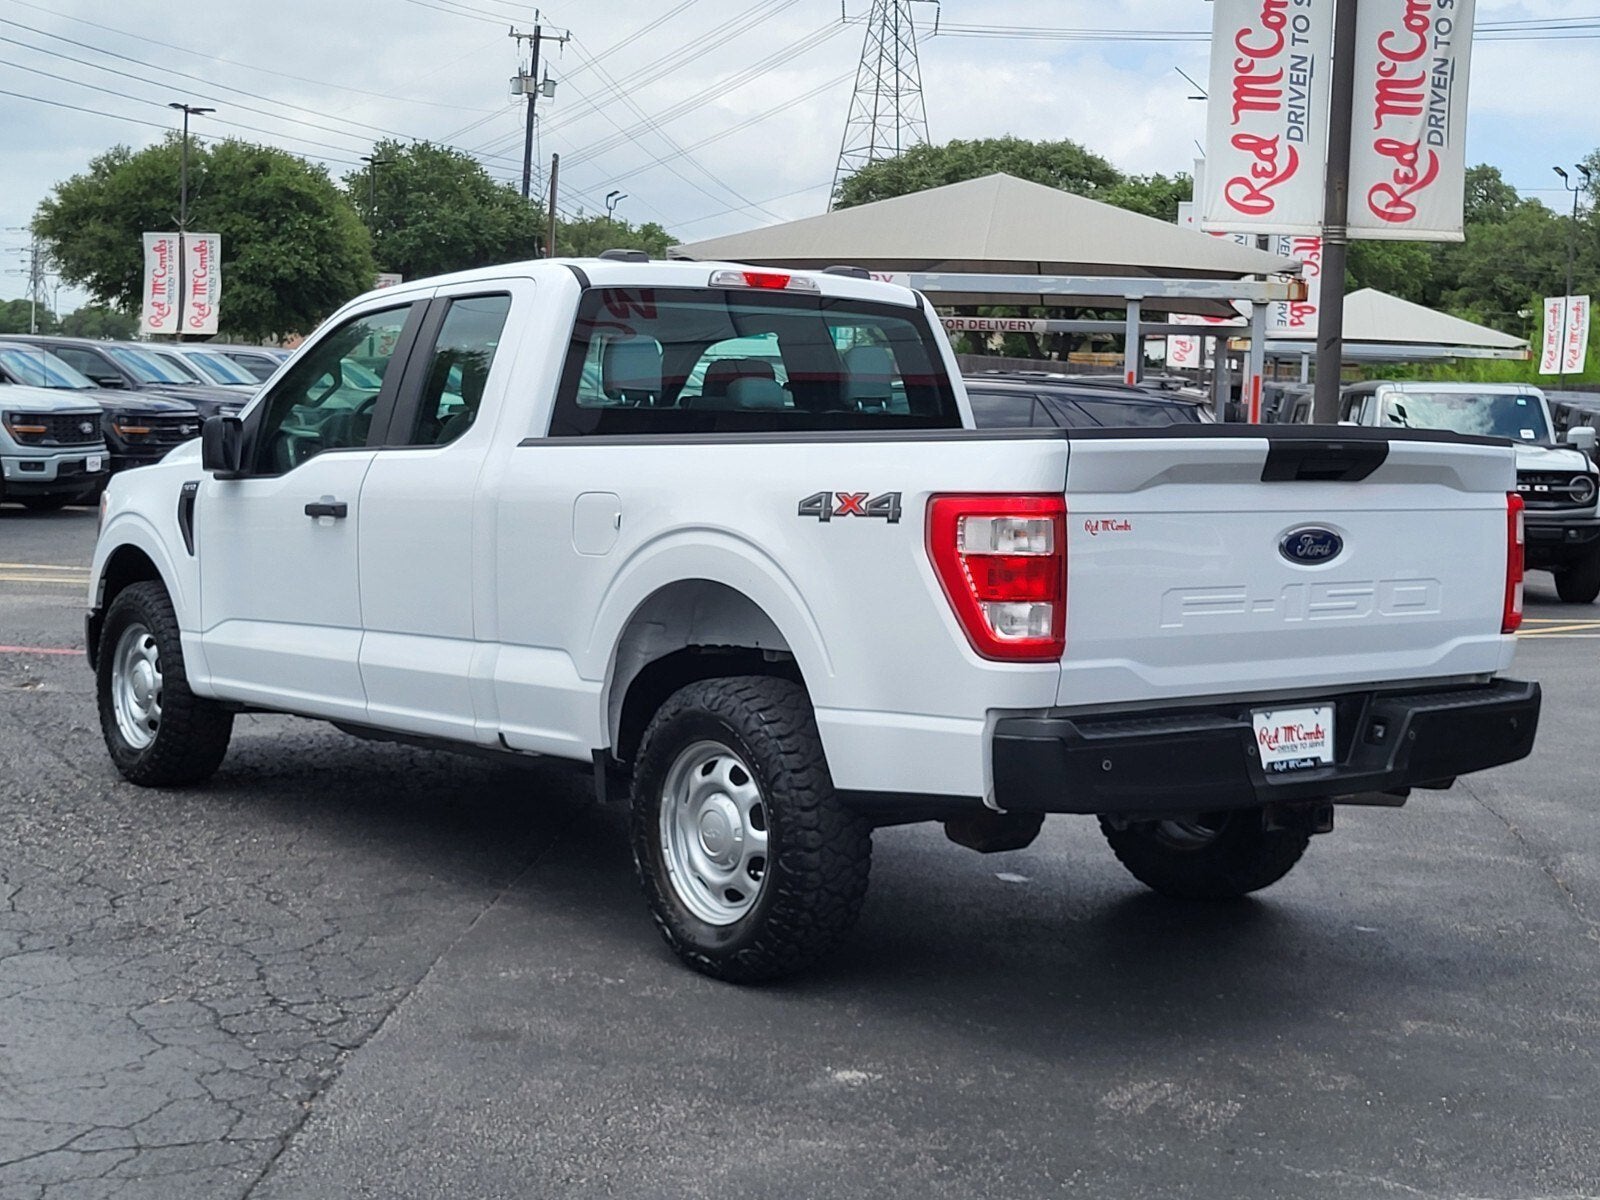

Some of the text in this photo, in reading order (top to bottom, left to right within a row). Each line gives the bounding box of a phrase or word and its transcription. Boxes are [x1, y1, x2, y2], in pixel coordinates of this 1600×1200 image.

[1291, 15, 1311, 47] TO
[1433, 18, 1453, 49] TO
[1224, 0, 1299, 216] Red McCo
[1286, 54, 1309, 143] DRIVEN
[1367, 0, 1440, 223] Red McCo
[1426, 57, 1450, 147] DRIVEN
[148, 301, 171, 328] Red
[189, 302, 212, 328] Red
[968, 319, 1036, 331] DELIVERY
[1084, 519, 1099, 536] Red
[1296, 533, 1332, 557] Ford
[1160, 578, 1443, 628] F-150
[1259, 722, 1326, 751] Red McCombs
[1277, 744, 1298, 753] DRIVEN
[1300, 742, 1307, 750] TO
